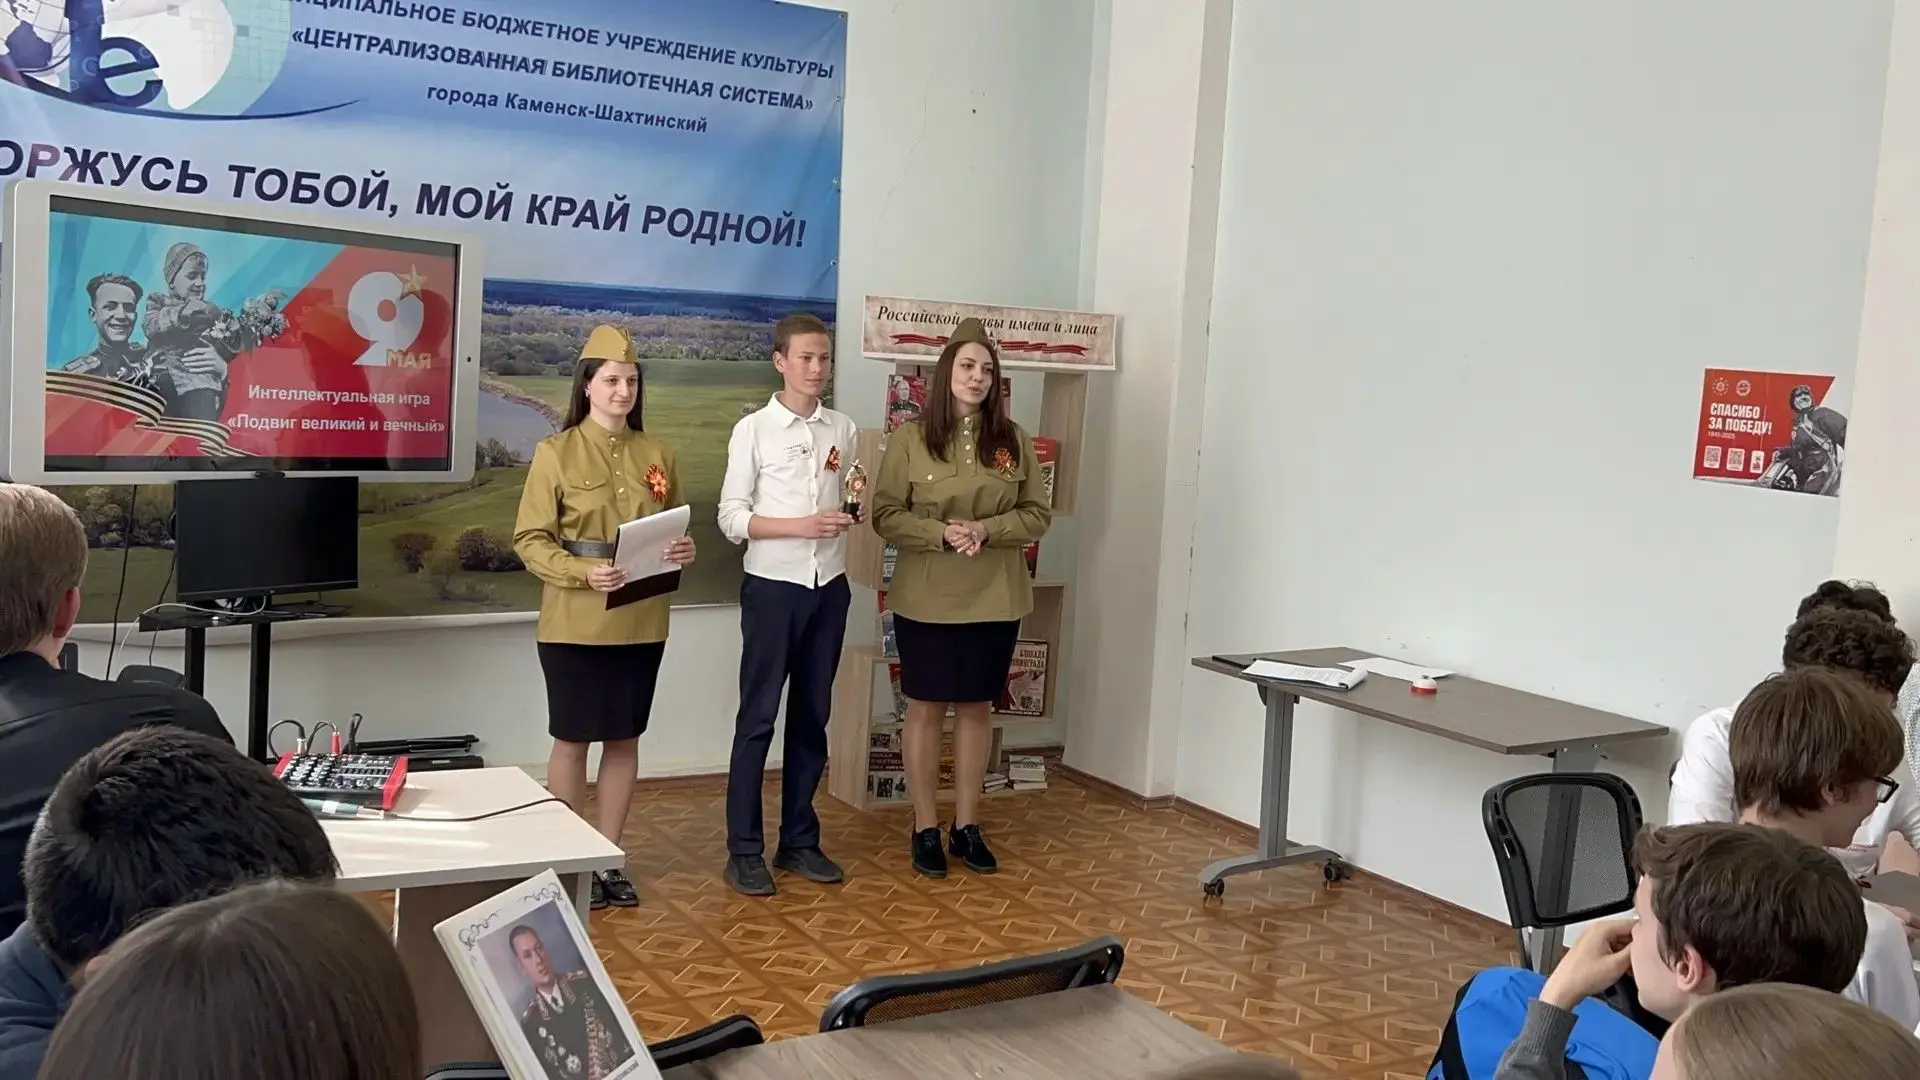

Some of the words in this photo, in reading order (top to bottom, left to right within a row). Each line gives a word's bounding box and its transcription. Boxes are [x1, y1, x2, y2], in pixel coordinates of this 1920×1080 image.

[462, 11, 599, 45] БЮДЖЕТНОЕ
[605, 32, 736, 65] УЧРЕЖДЕНИЕ
[741, 53, 834, 79] КУЛЬТУРЫ
[292, 27, 547, 76] «ЦЕНТРАЛИЗОВАННАЯ
[551, 61, 714, 98] БИБЛИОТЕЧНАЯ
[720, 84, 814, 111] СИСТЕМА»
[427, 86, 498, 107] города
[505, 93, 708, 134] Каменск-Шахтинский
[0, 139, 208, 194] ОРЖУСЬ
[228, 163, 399, 218] ТОБОЙ,
[415, 181, 514, 221] МОЙ
[526, 194, 630, 233] КРАЙ
[642, 206, 807, 248] РОДНОЙ!
[348, 271, 425, 367] 9
[877, 305, 962, 326] Российской
[979, 317, 1004, 329] авы
[1008, 320, 1050, 332] имена
[1054, 322, 1062, 333] и
[1064, 323, 1099, 337] лица
[387, 349, 432, 370] МАЯ
[248, 385, 394, 405] Интеллектуальная
[399, 394, 431, 407] игра
[1710, 402, 1761, 419] СПАСИБО
[227, 414, 297, 430] «Подвиг
[302, 417, 365, 431] великий
[369, 421, 379, 431] и
[384, 420, 445, 433] вечный»
[1708, 416, 1723, 430] ЗА
[1725, 418, 1773, 436] ПОБЕДУ!
